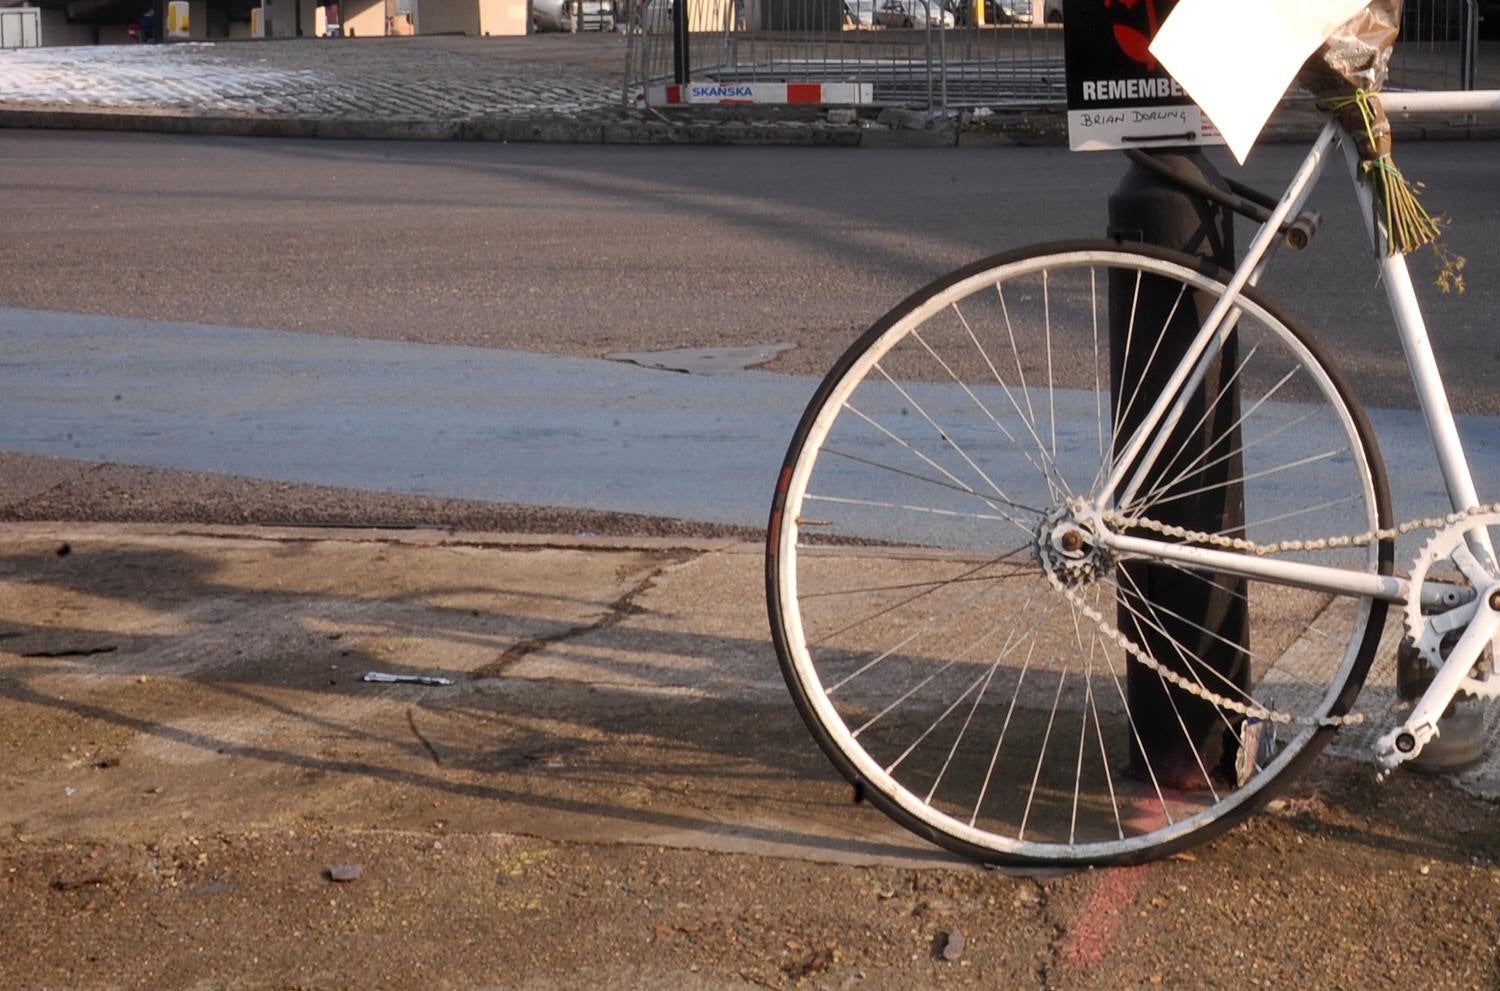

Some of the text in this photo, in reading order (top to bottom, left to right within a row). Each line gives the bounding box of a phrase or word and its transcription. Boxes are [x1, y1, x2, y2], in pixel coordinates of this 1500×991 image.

[692, 87, 753, 97] SKANSKA
[1083, 78, 1188, 100] REMEMBE
[1080, 113, 1125, 127] BRIAN
